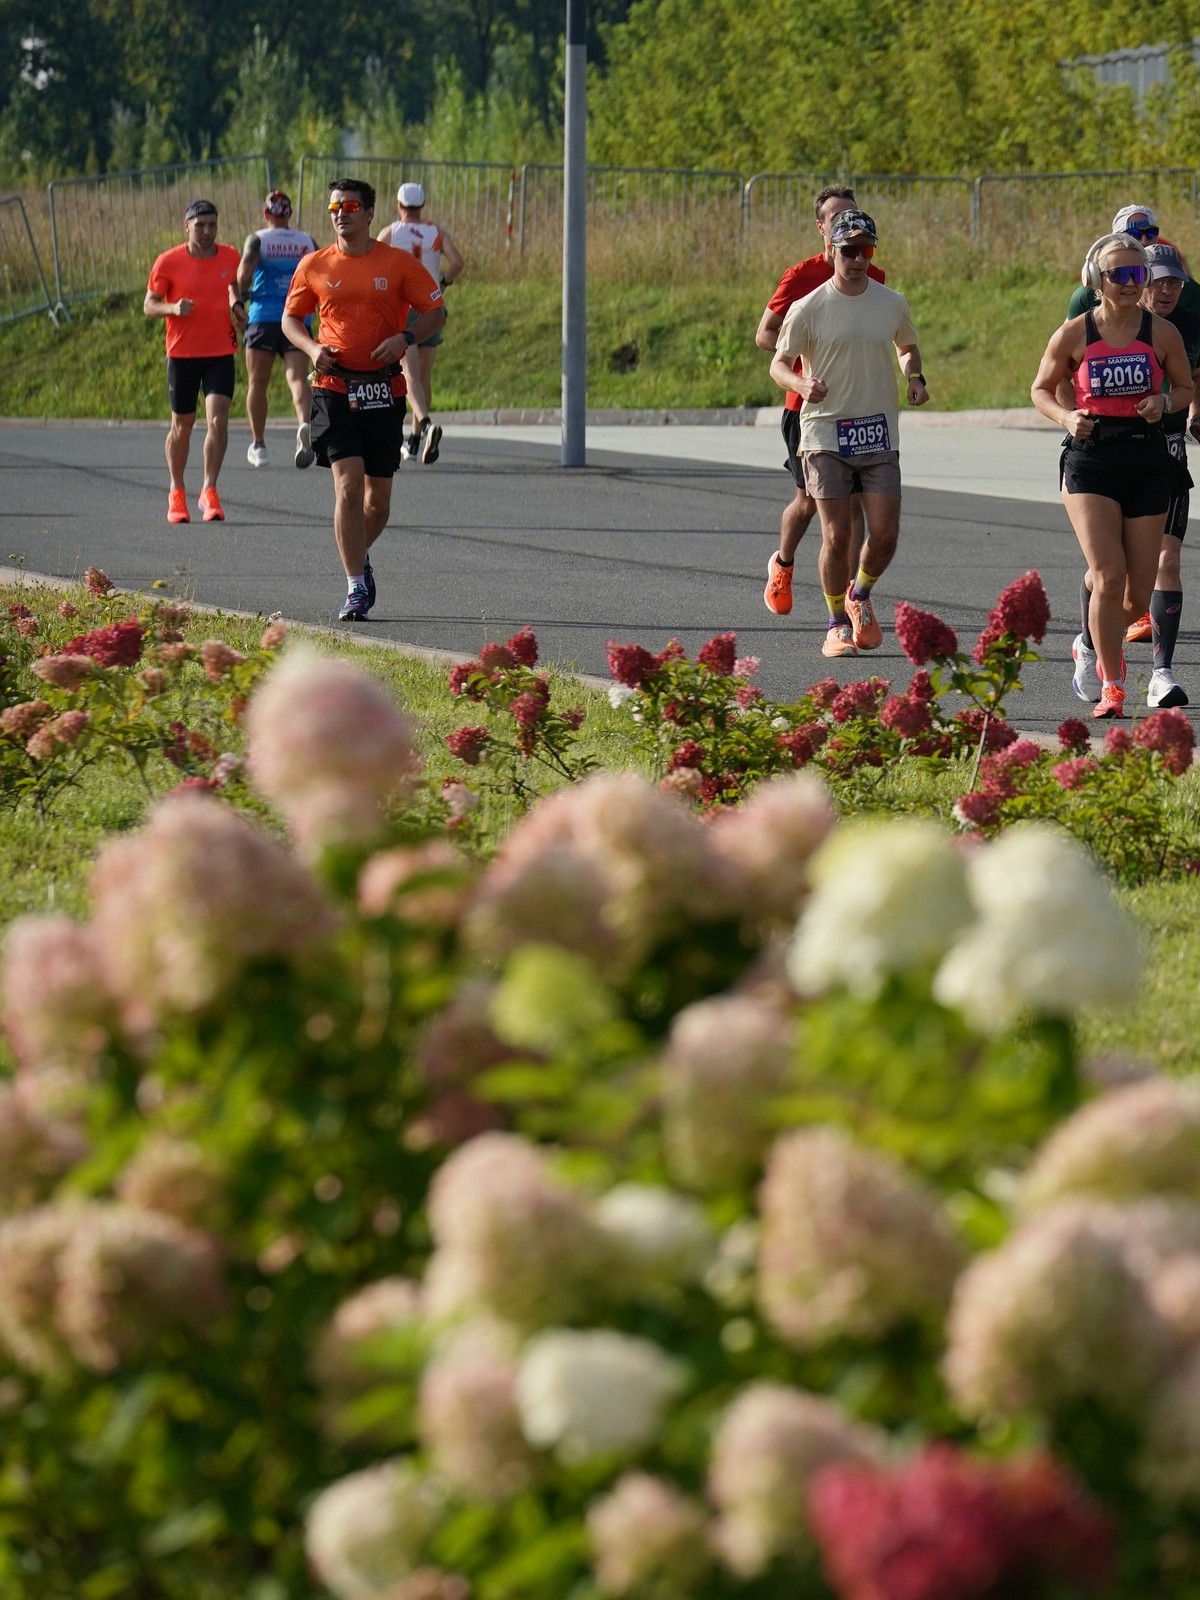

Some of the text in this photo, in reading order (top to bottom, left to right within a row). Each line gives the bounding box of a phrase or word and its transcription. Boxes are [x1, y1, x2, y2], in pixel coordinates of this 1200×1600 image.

[374, 277, 388, 291] 10
[1107, 356, 1146, 365] МАРАФОН
[1103, 364, 1145, 388] 2016
[356, 382, 389, 401] 4093
[854, 417, 884, 426] МАРАФОН
[848, 424, 884, 446] 2059
